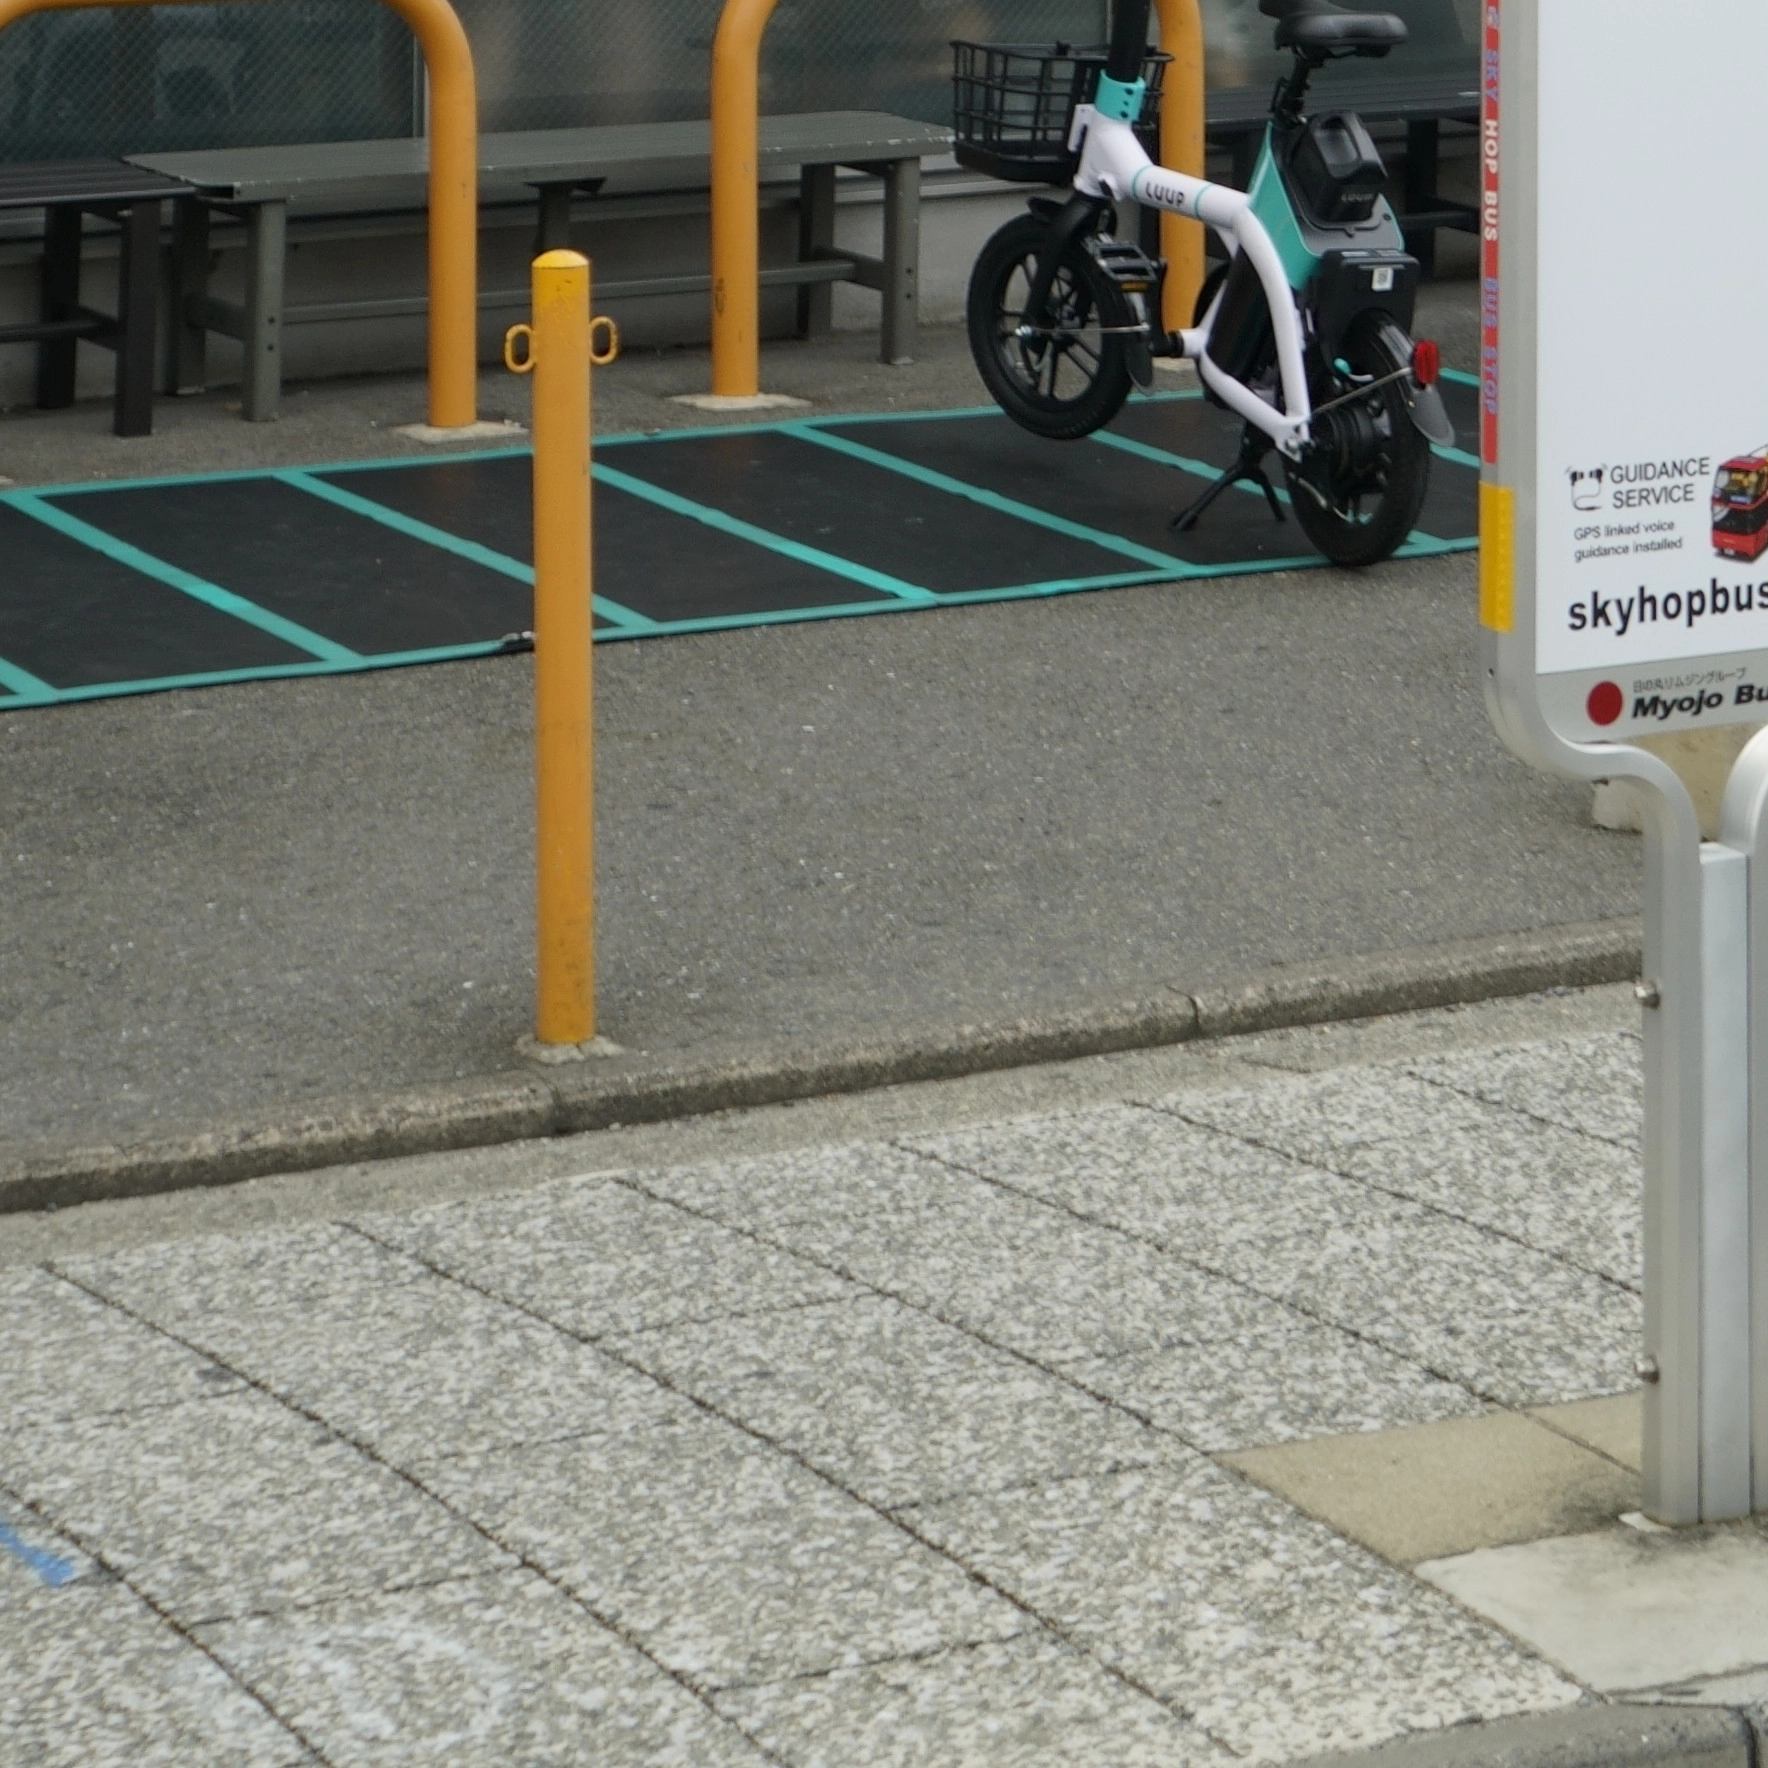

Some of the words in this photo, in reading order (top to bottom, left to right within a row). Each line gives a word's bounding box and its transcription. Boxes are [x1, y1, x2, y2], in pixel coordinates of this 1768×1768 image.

[1483, 121, 1498, 172] HOP
[1145, 181, 1186, 207] LUUP
[1483, 192, 1498, 241] BUS
[1610, 457, 1711, 484] GUIDANCE
[1612, 483, 1694, 510] SERVICE
[1574, 526, 1601, 541] GPS
[1605, 521, 1639, 538] linked
[1642, 520, 1675, 533] voice
[1574, 544, 1629, 563] guidance
[1632, 536, 1683, 554] installed
[1632, 687, 1722, 720] Myojo
